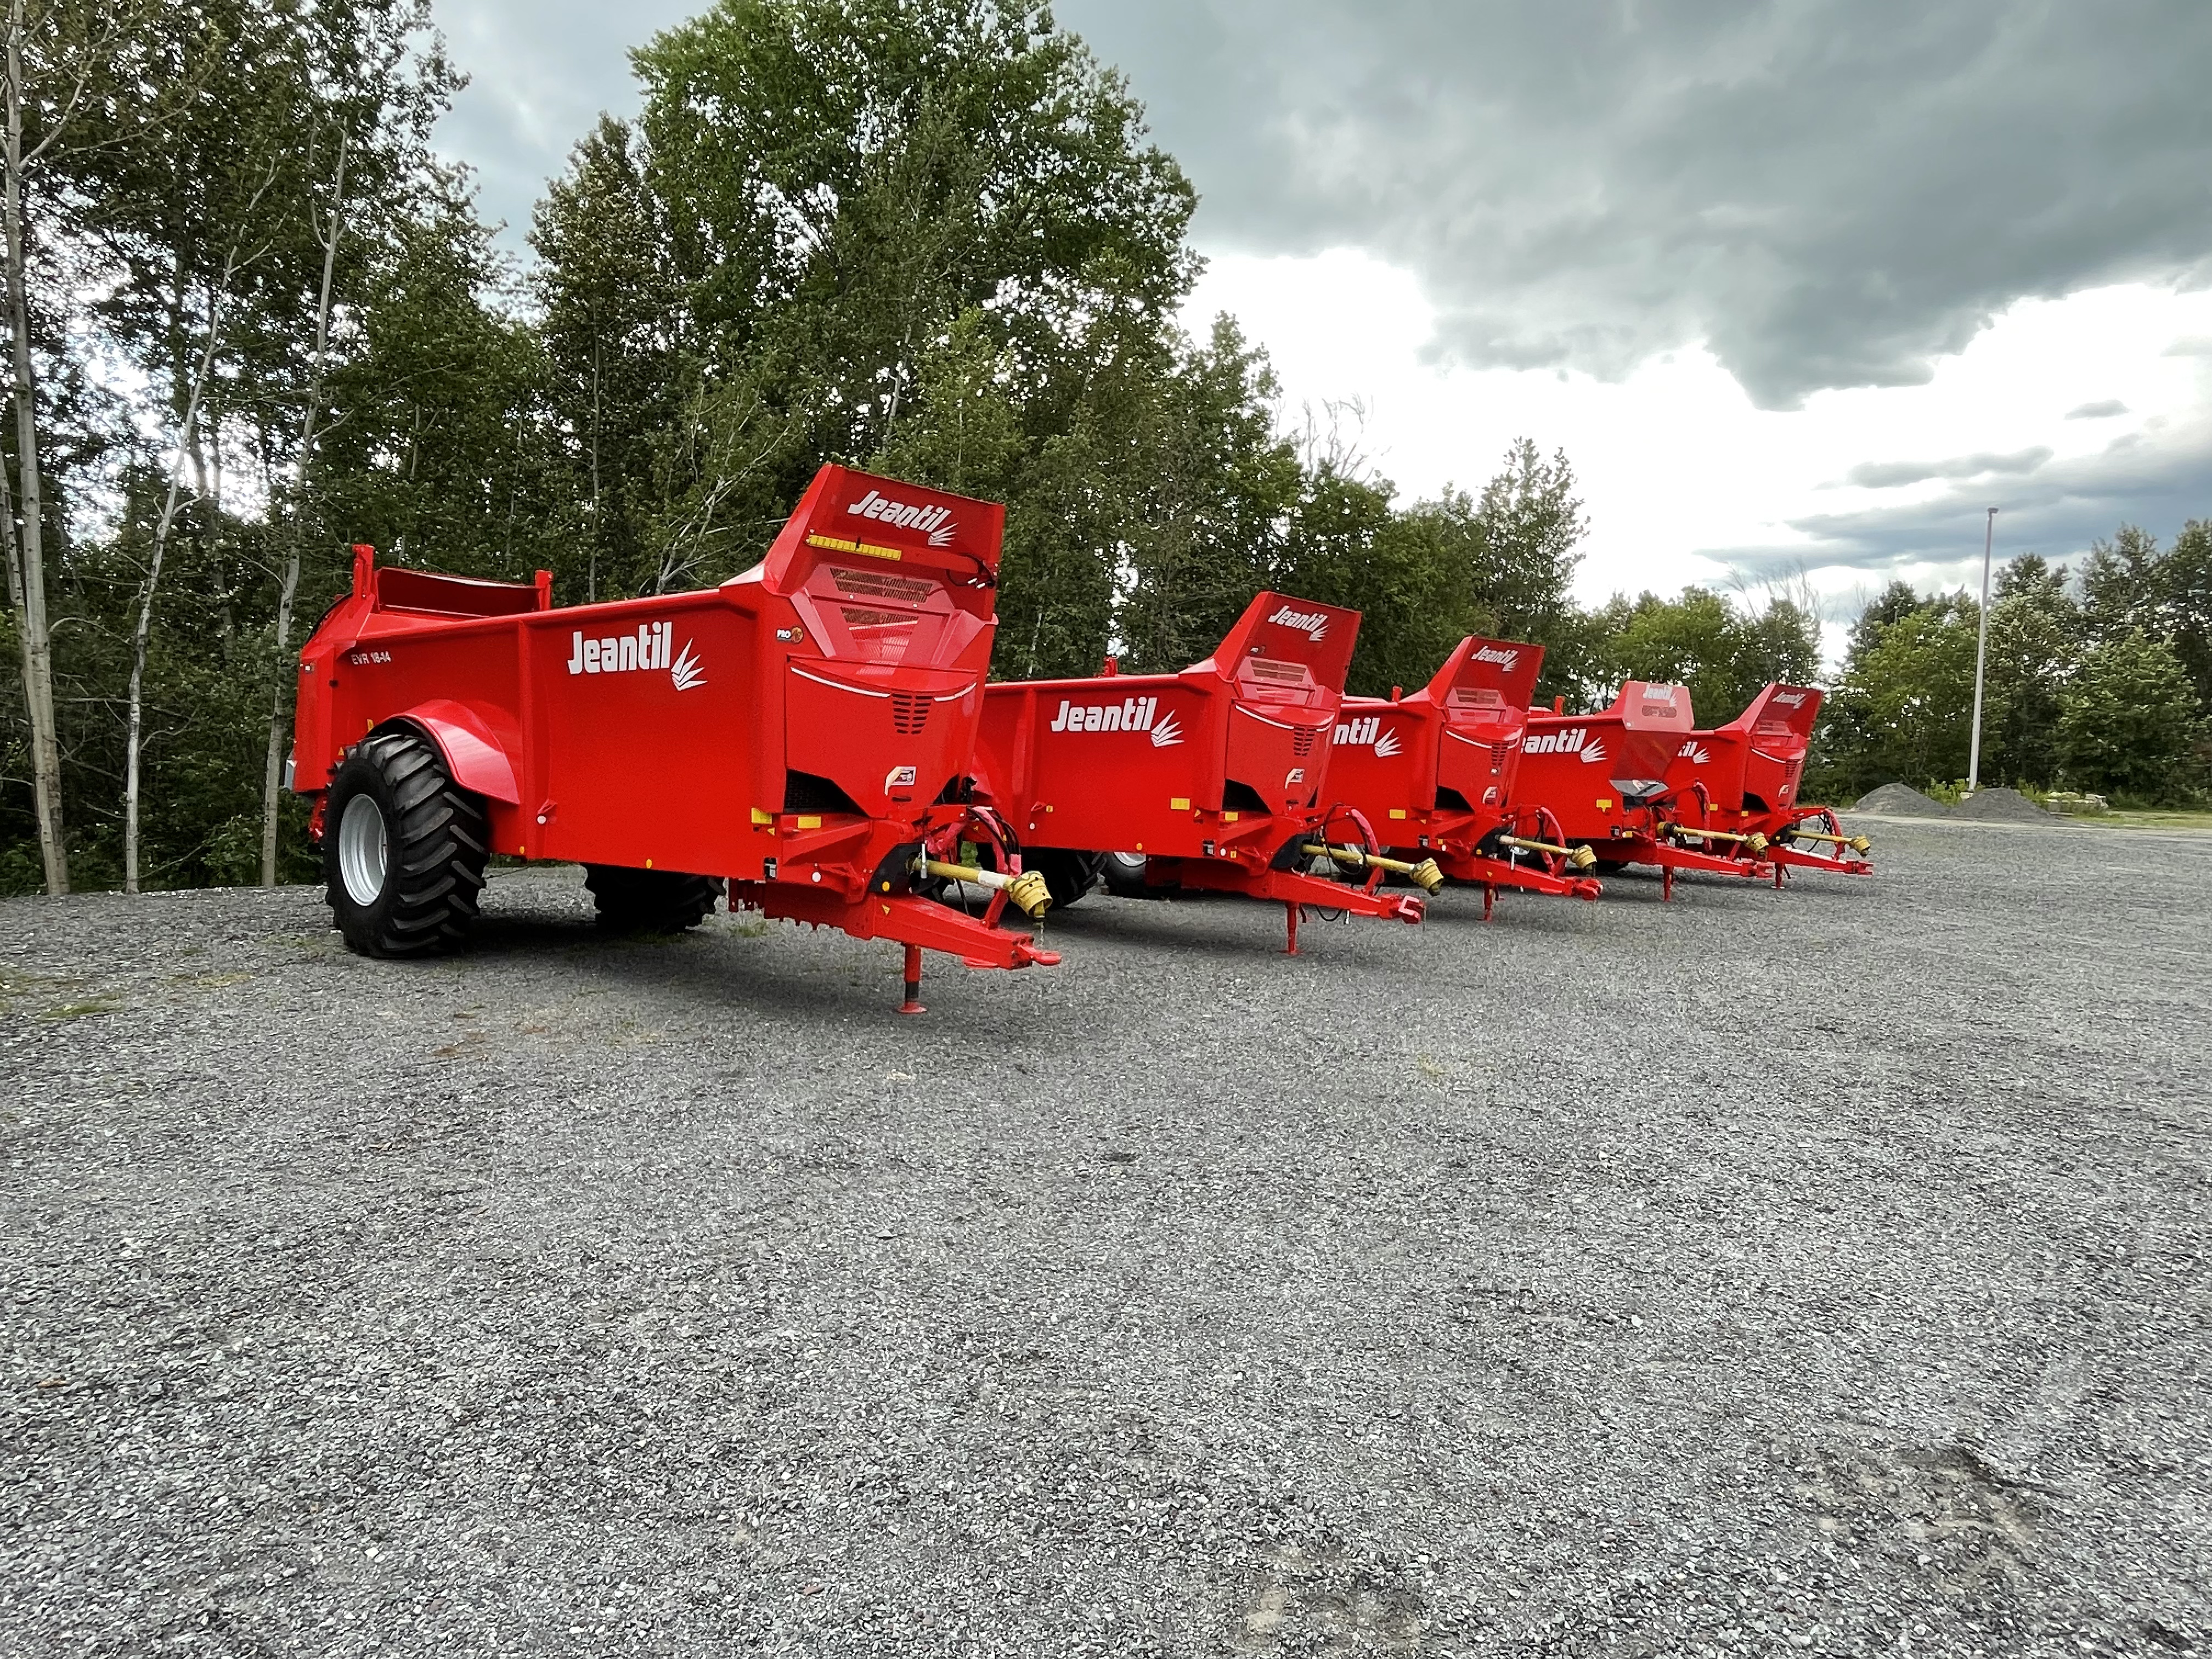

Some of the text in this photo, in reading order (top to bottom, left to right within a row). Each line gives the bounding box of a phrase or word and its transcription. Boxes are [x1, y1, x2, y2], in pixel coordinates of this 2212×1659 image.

[848, 490, 952, 532] Jeantil
[1268, 605, 1328, 632] Jeantil
[567, 621, 673, 675] Jeantil
[1471, 645, 1518, 665] Jeantil
[1051, 697, 1158, 732] Jeantil
[1333, 717, 1380, 744] ntil
[1521, 729, 1587, 753] antil
